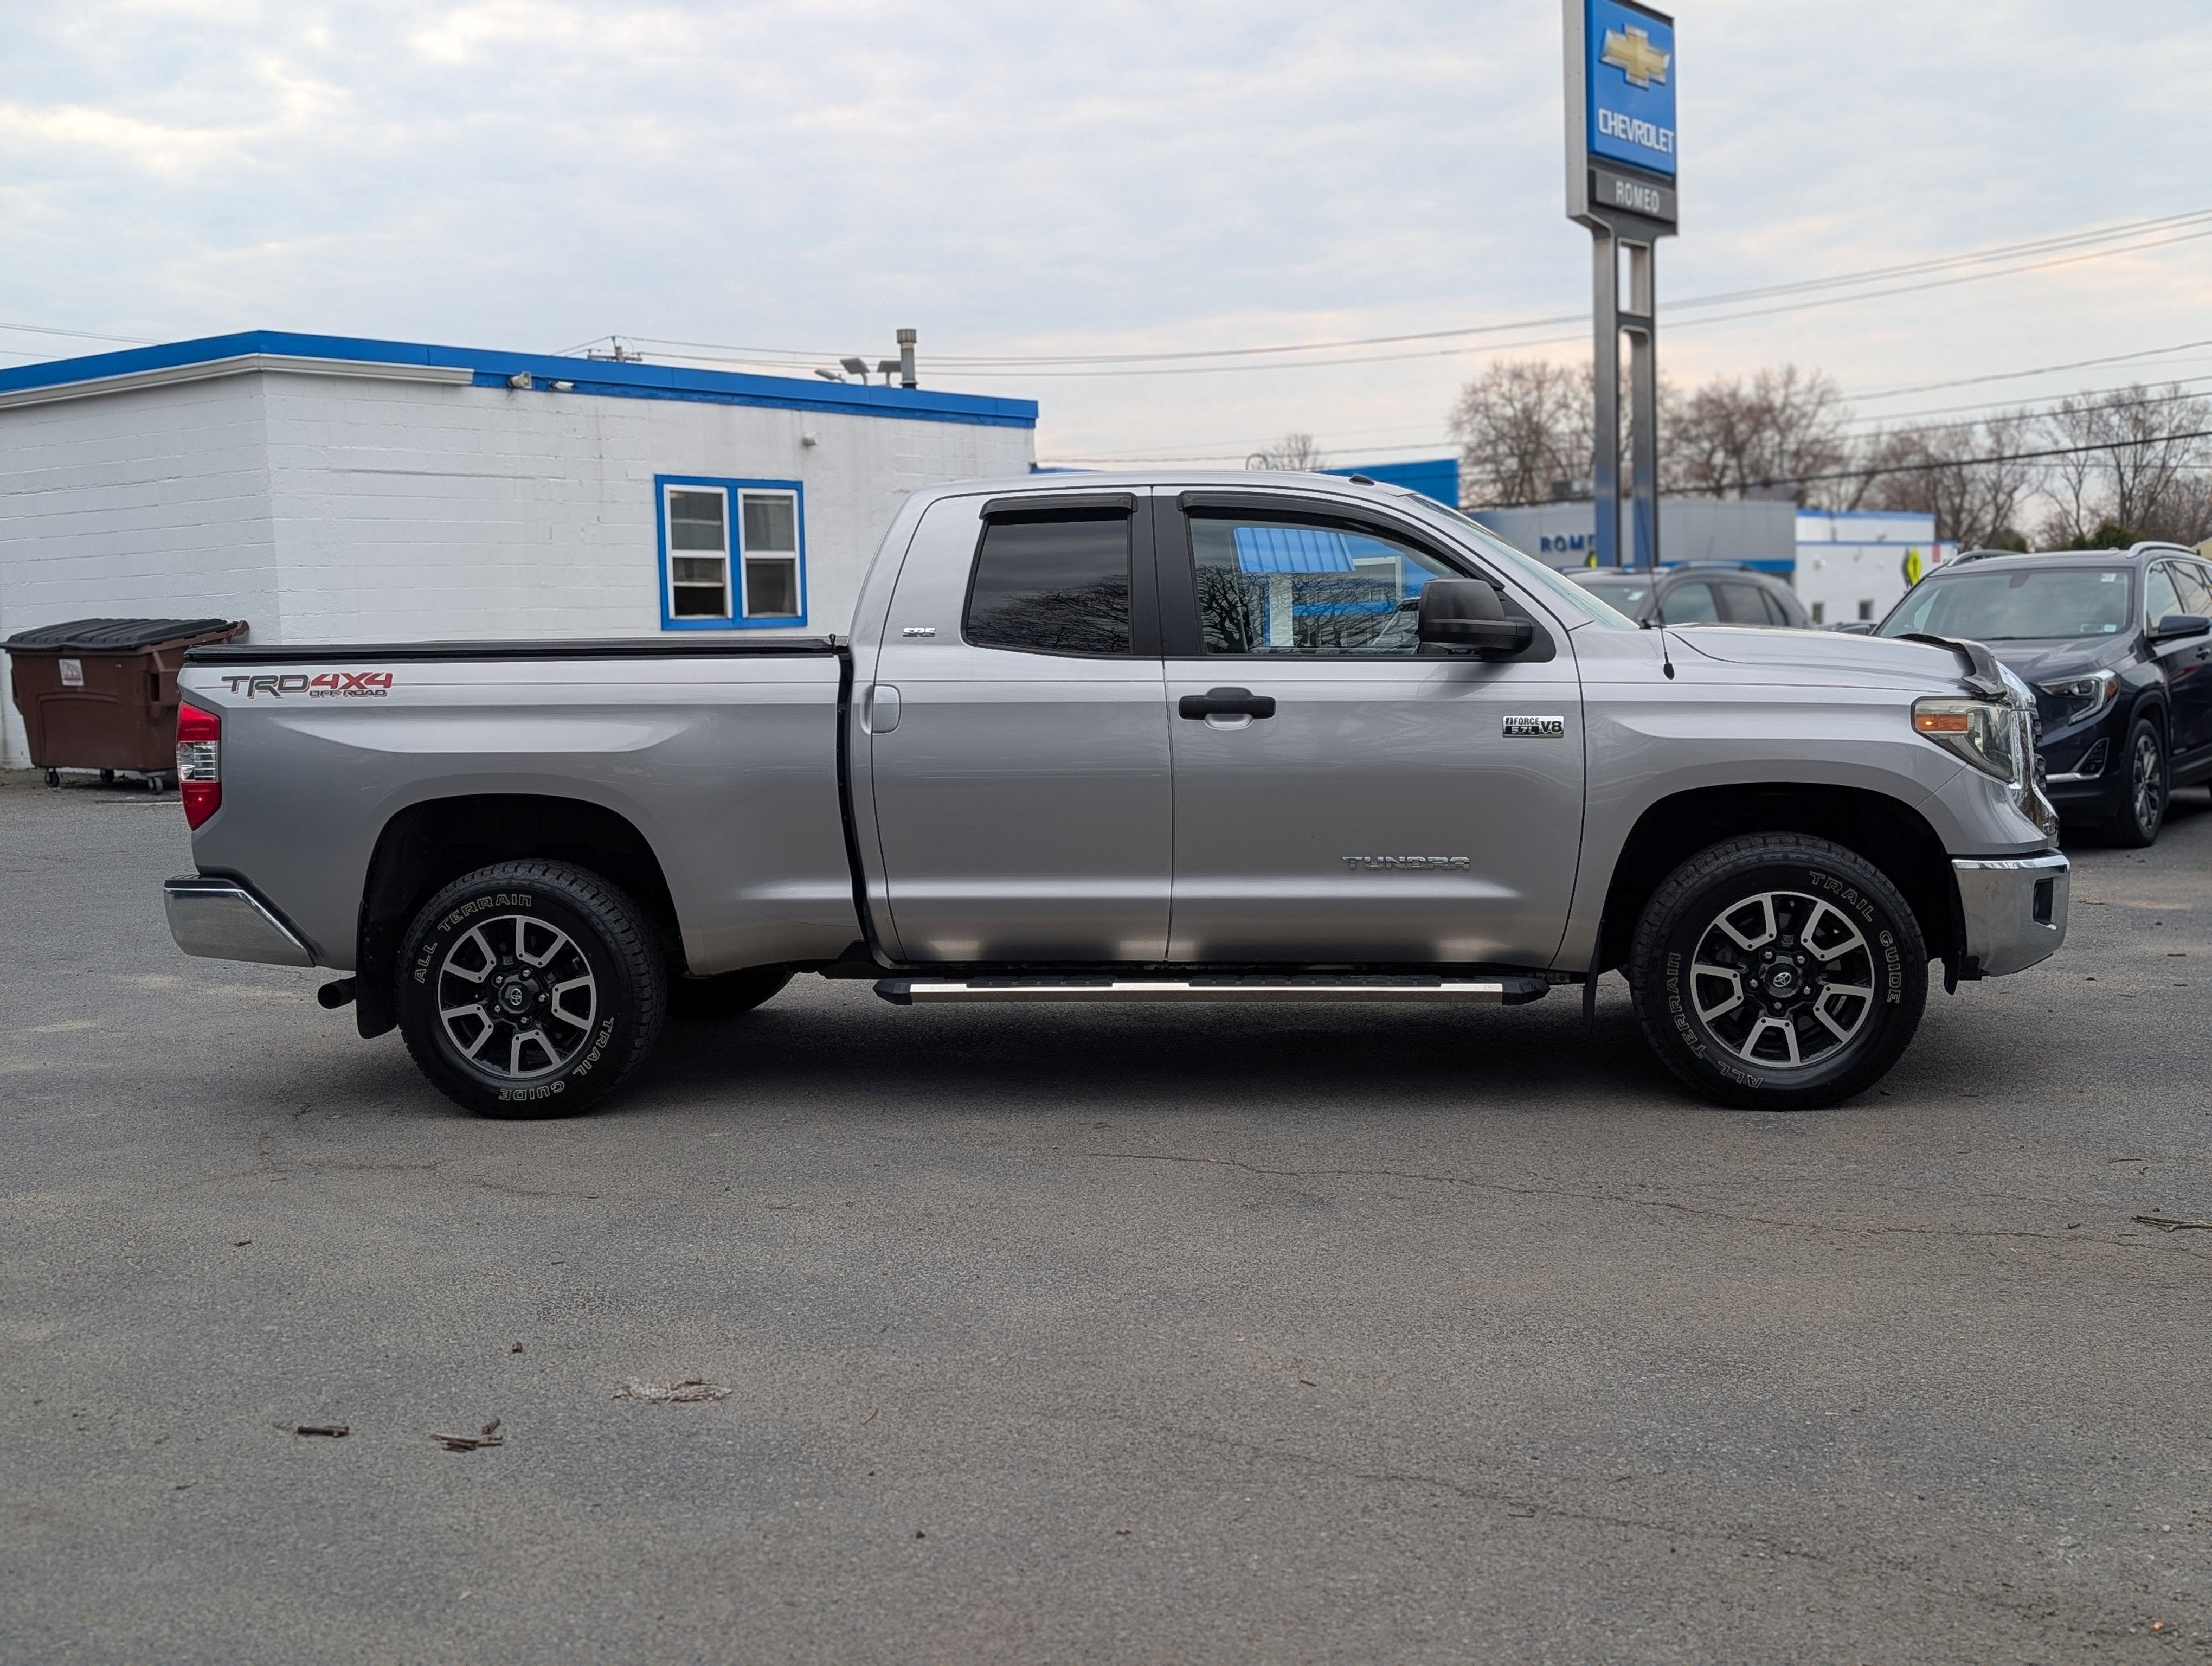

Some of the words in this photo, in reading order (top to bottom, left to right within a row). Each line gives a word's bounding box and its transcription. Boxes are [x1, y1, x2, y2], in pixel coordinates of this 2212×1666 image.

[1598, 108, 1674, 153] CHEVROLET
[1616, 180, 1660, 213] ROMEO
[309, 689, 341, 698] OFF
[343, 689, 388, 698] ROAD
[1540, 721, 1562, 734] V8
[1342, 856, 1470, 870] TUNDRA
[414, 941, 438, 984] ALL
[437, 894, 532, 932] TERRAIN
[1809, 871, 1874, 922] TRAIL
[1879, 930, 1902, 1004] GUIDE
[1666, 952, 1707, 1059] TERRAIN
[573, 1017, 614, 1076] TRAIL
[498, 1080, 565, 1101] GUIDE
[1716, 1061, 1764, 1089] ALL
